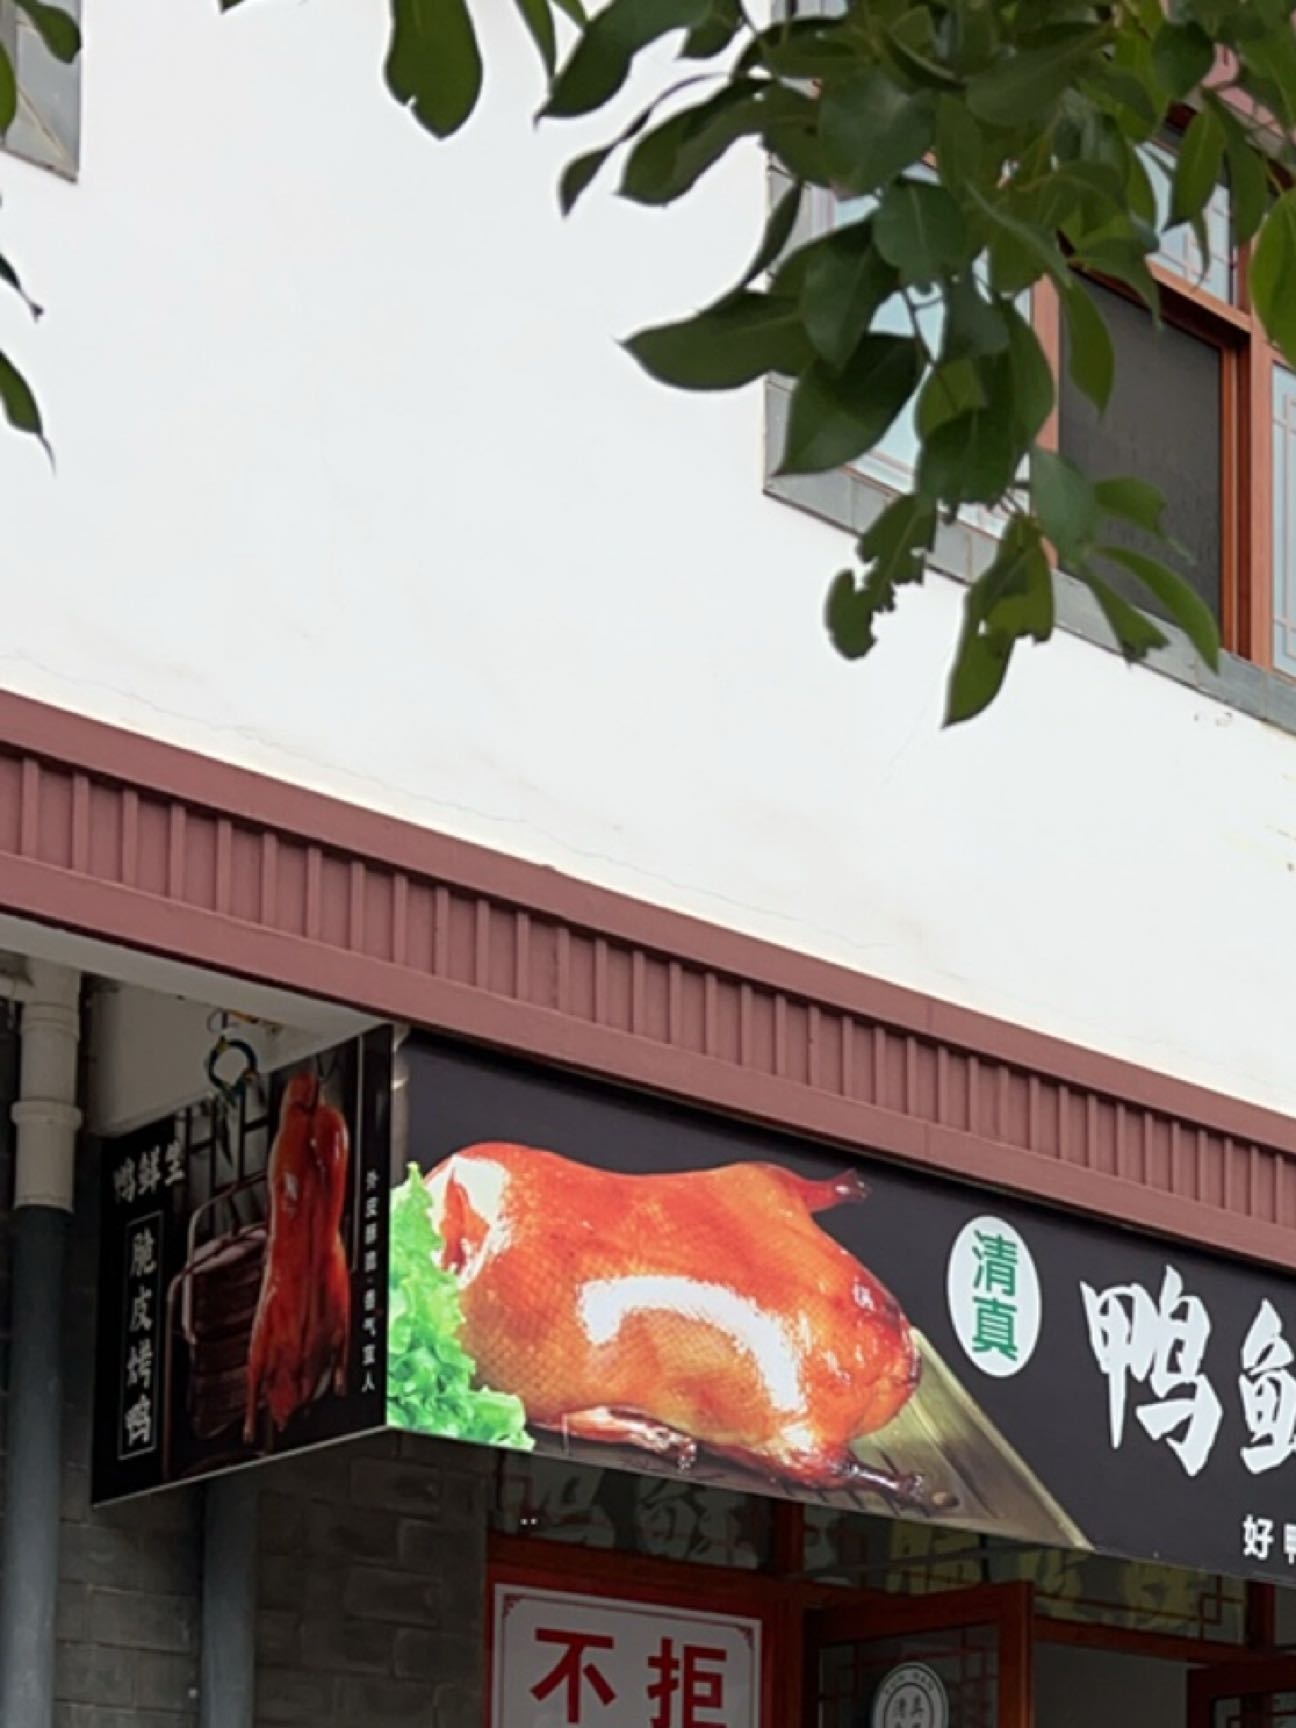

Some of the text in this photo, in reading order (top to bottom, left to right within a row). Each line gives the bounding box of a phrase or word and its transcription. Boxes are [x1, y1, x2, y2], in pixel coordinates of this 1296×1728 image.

[124, 1231, 156, 1445] 脆皮烤鸭
[972, 1229, 1019, 1362] 清真
